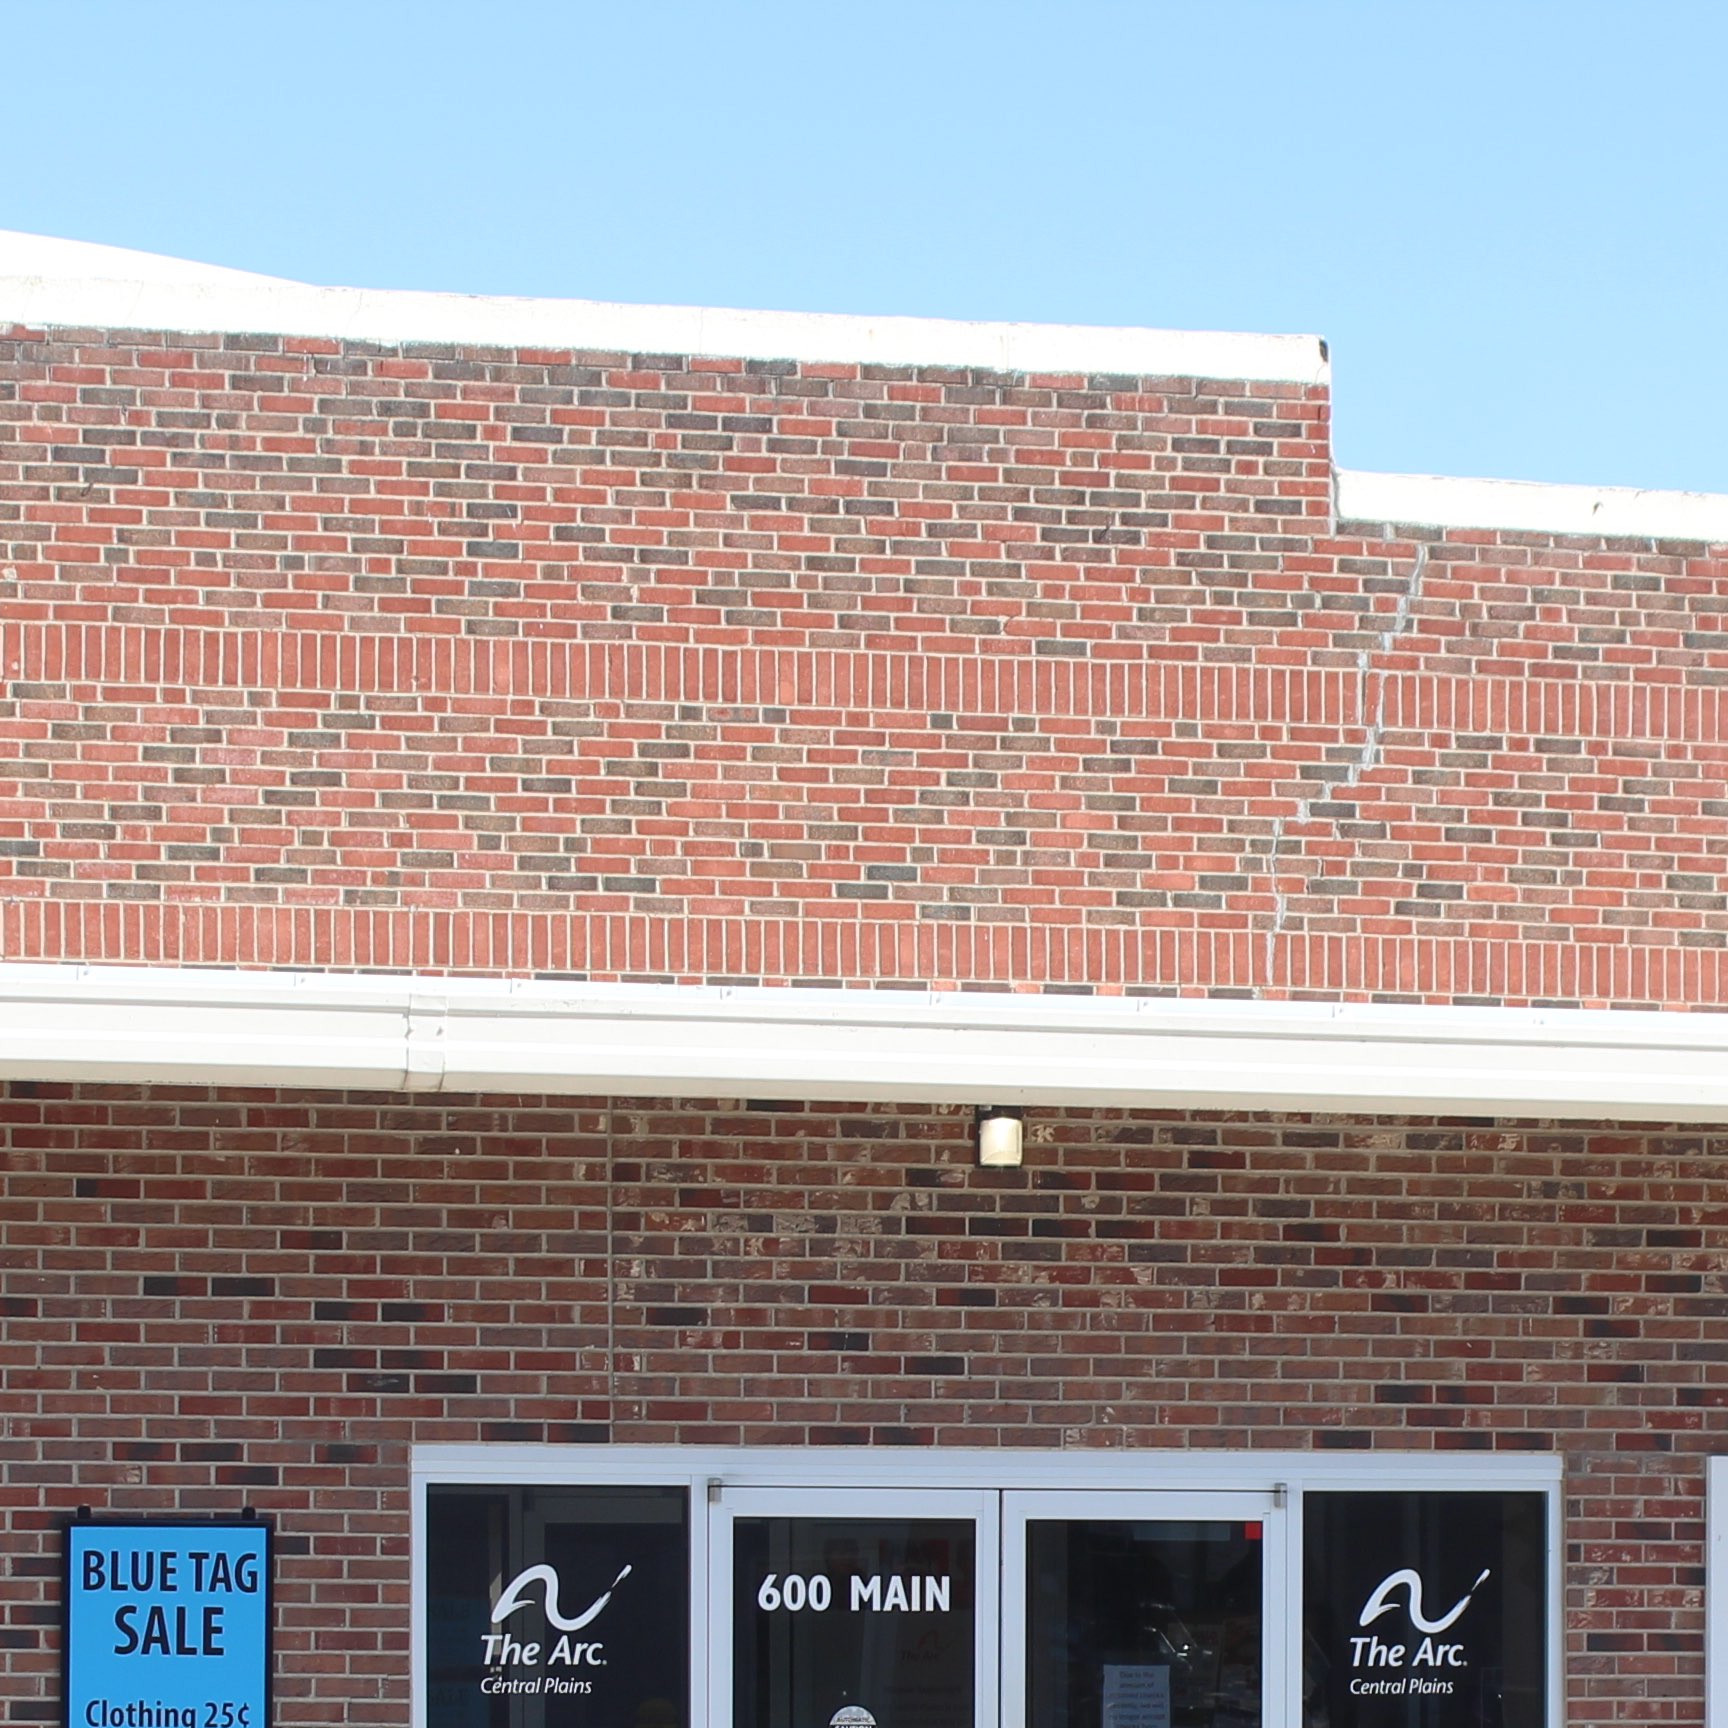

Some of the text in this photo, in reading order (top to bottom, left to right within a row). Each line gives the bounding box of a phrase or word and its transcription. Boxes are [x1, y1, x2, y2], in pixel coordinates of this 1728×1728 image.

[82, 1550, 258, 1593] BLUE TAG
[758, 1574, 950, 1611] 600 MAIN
[114, 1605, 224, 1656] SALE
[480, 1634, 541, 1666] The
[1350, 1636, 1405, 1667] The
[480, 1677, 592, 1694] Central Plains
[1350, 1679, 1454, 1694] Central Plains
[204, 1702, 250, 1728] 25¢
